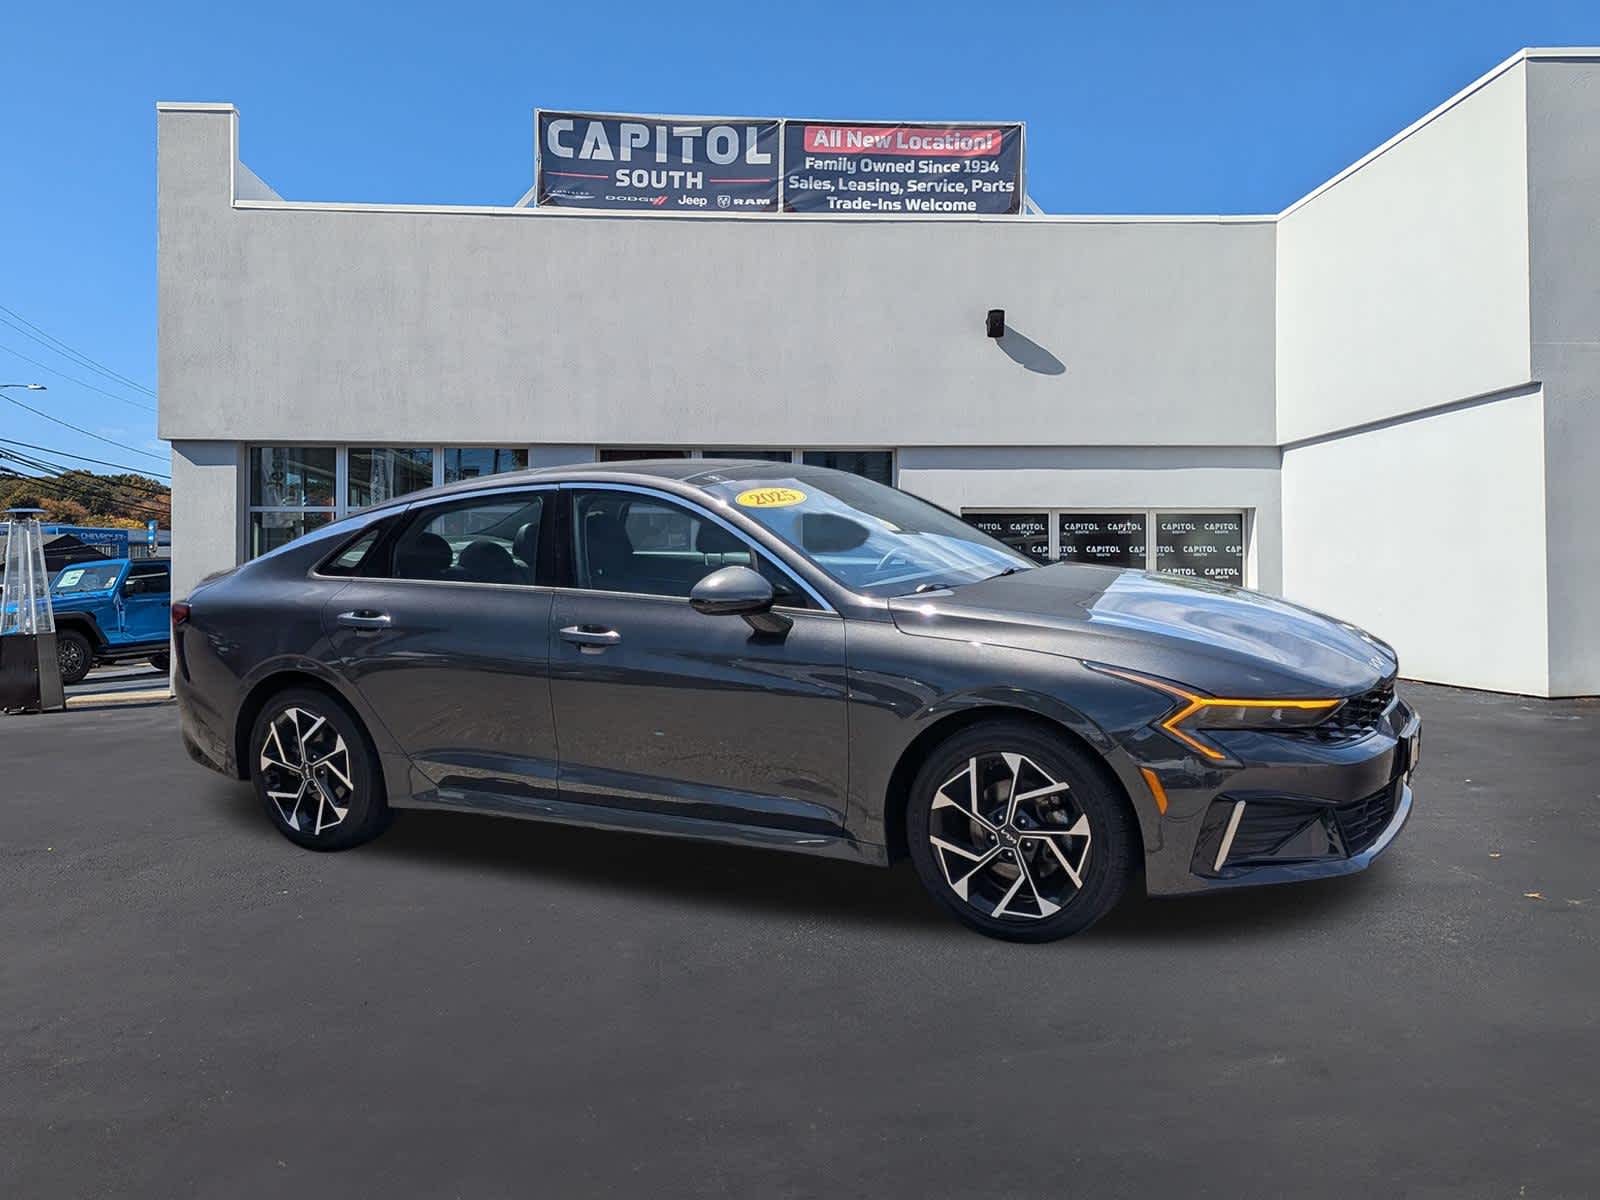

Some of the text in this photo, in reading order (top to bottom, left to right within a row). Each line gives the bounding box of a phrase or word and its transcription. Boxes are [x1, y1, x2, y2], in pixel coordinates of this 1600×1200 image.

[547, 119, 771, 165] CAPITOL
[813, 129, 993, 151] All New Location!
[805, 156, 1000, 175] Family Owned Since 1934
[615, 168, 703, 190] SOUTH
[788, 175, 1015, 195] Sales, Leasing, Service, Parts
[678, 194, 708, 207] Jeep
[733, 198, 770, 206] RAM
[826, 196, 977, 212] Trade-Ins Welcome
[749, 490, 797, 505] 2025
[1204, 568, 1239, 576] CAPITOL
